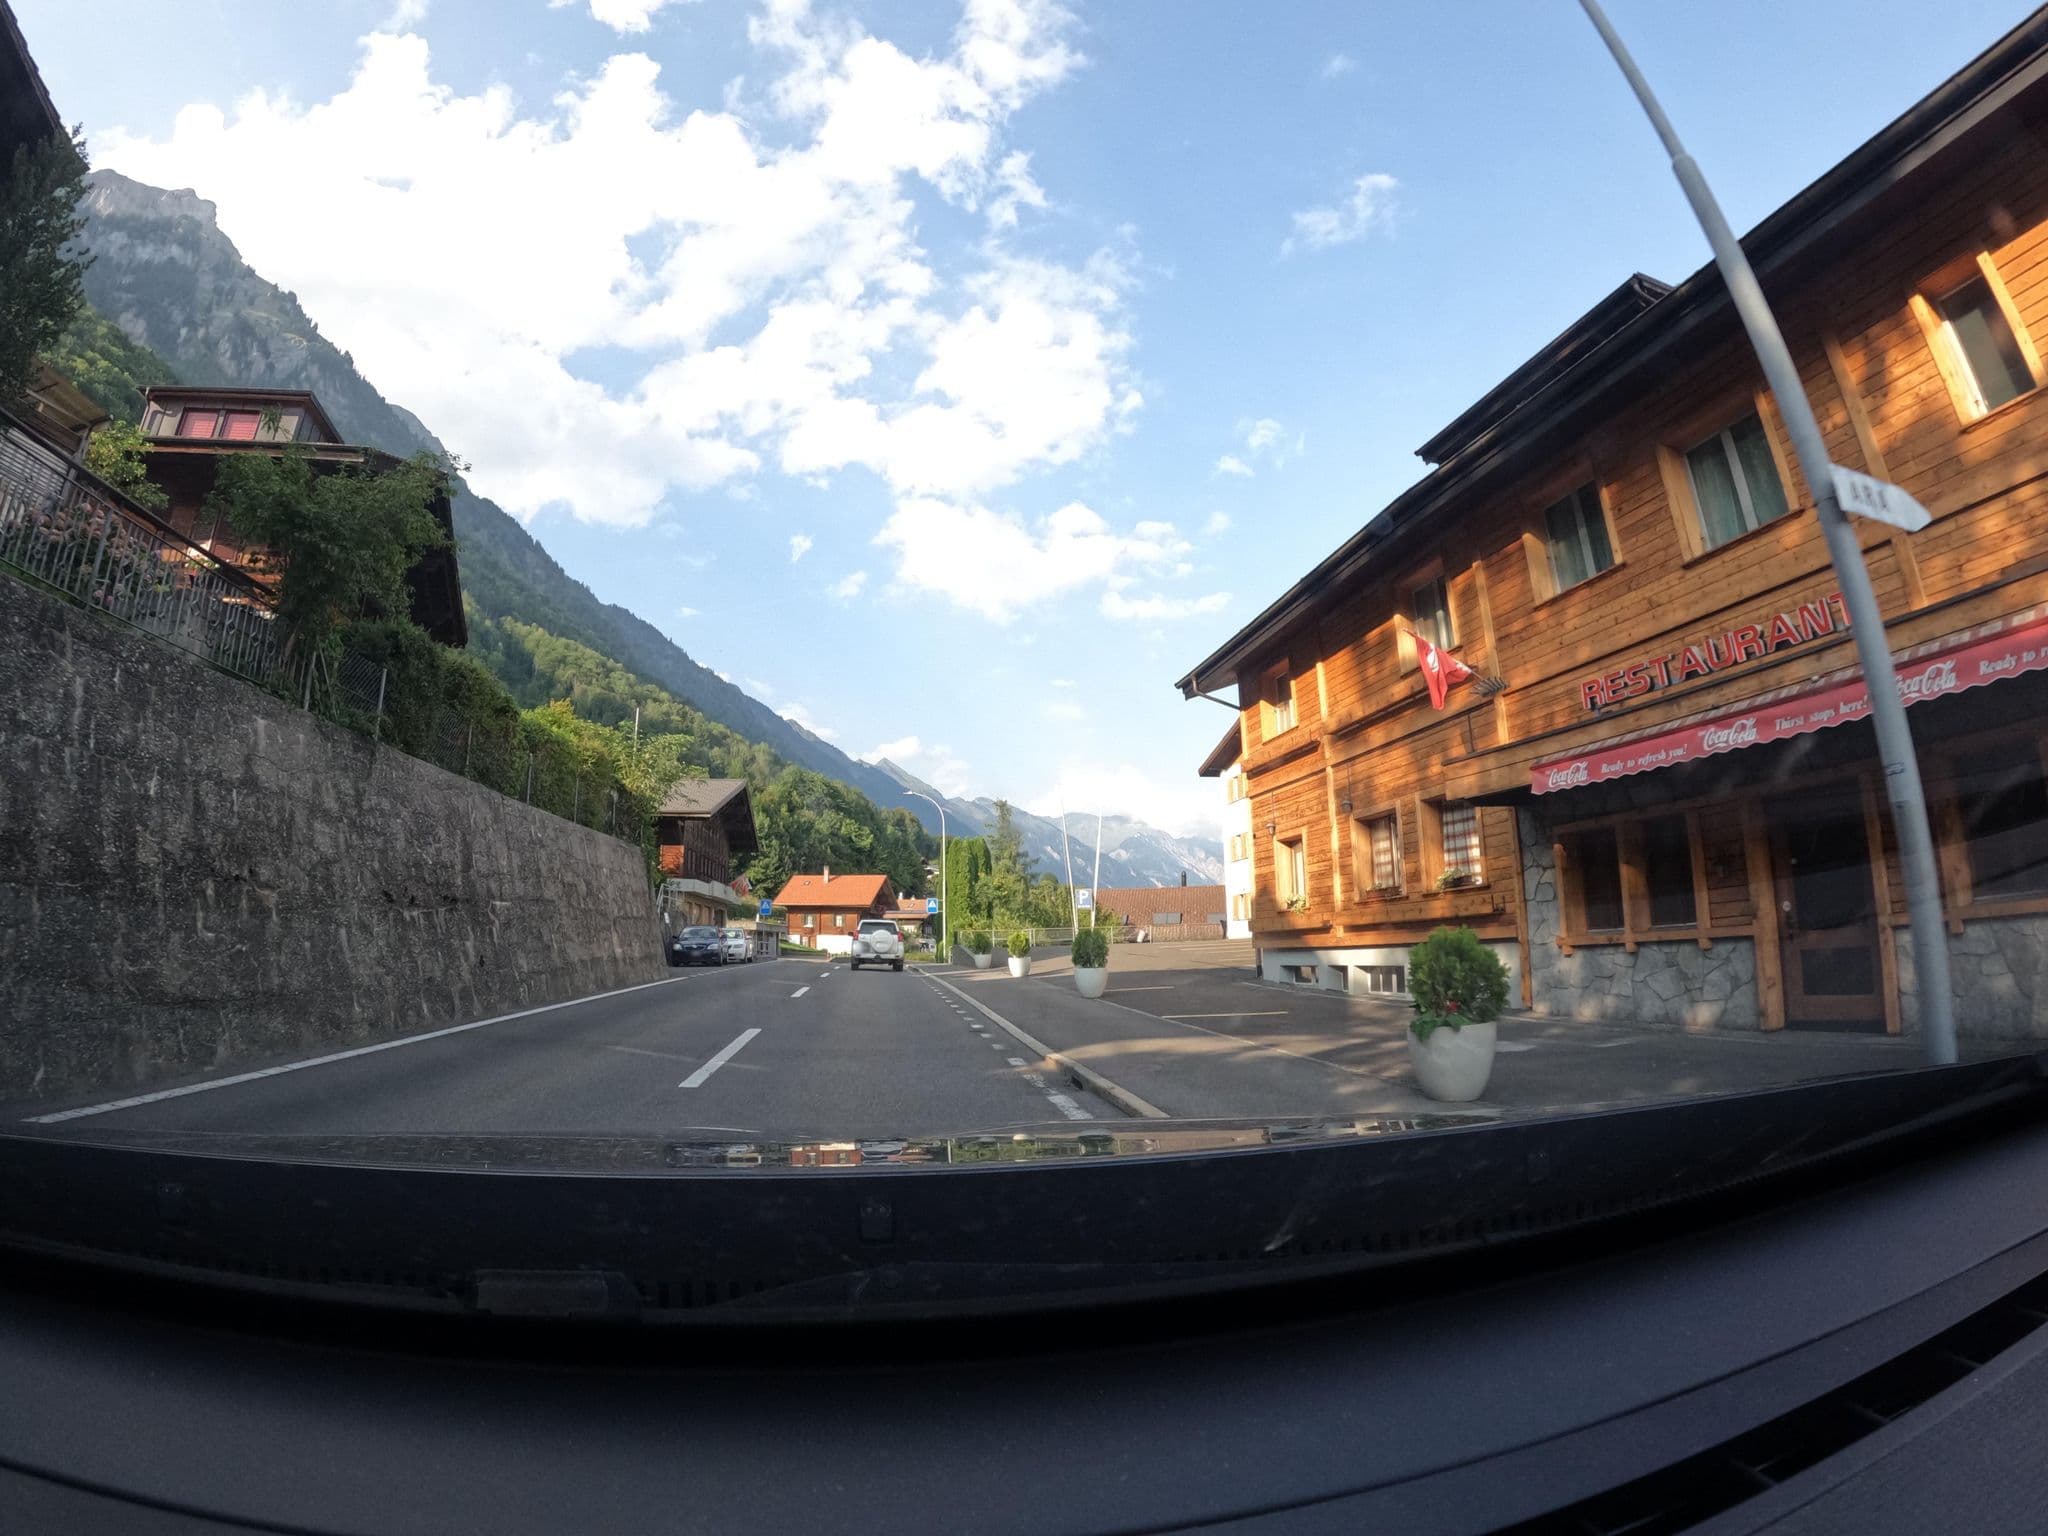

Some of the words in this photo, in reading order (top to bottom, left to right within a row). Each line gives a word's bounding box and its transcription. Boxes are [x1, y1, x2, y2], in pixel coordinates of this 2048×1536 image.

[1581, 592, 1852, 709] RESTAURANT
[1601, 760, 1624, 774] Ready
[1627, 759, 1636, 769] to
[1638, 749, 1667, 767] refresh
[1775, 715, 1804, 731] Thirst
[1080, 890, 1089, 905] P
